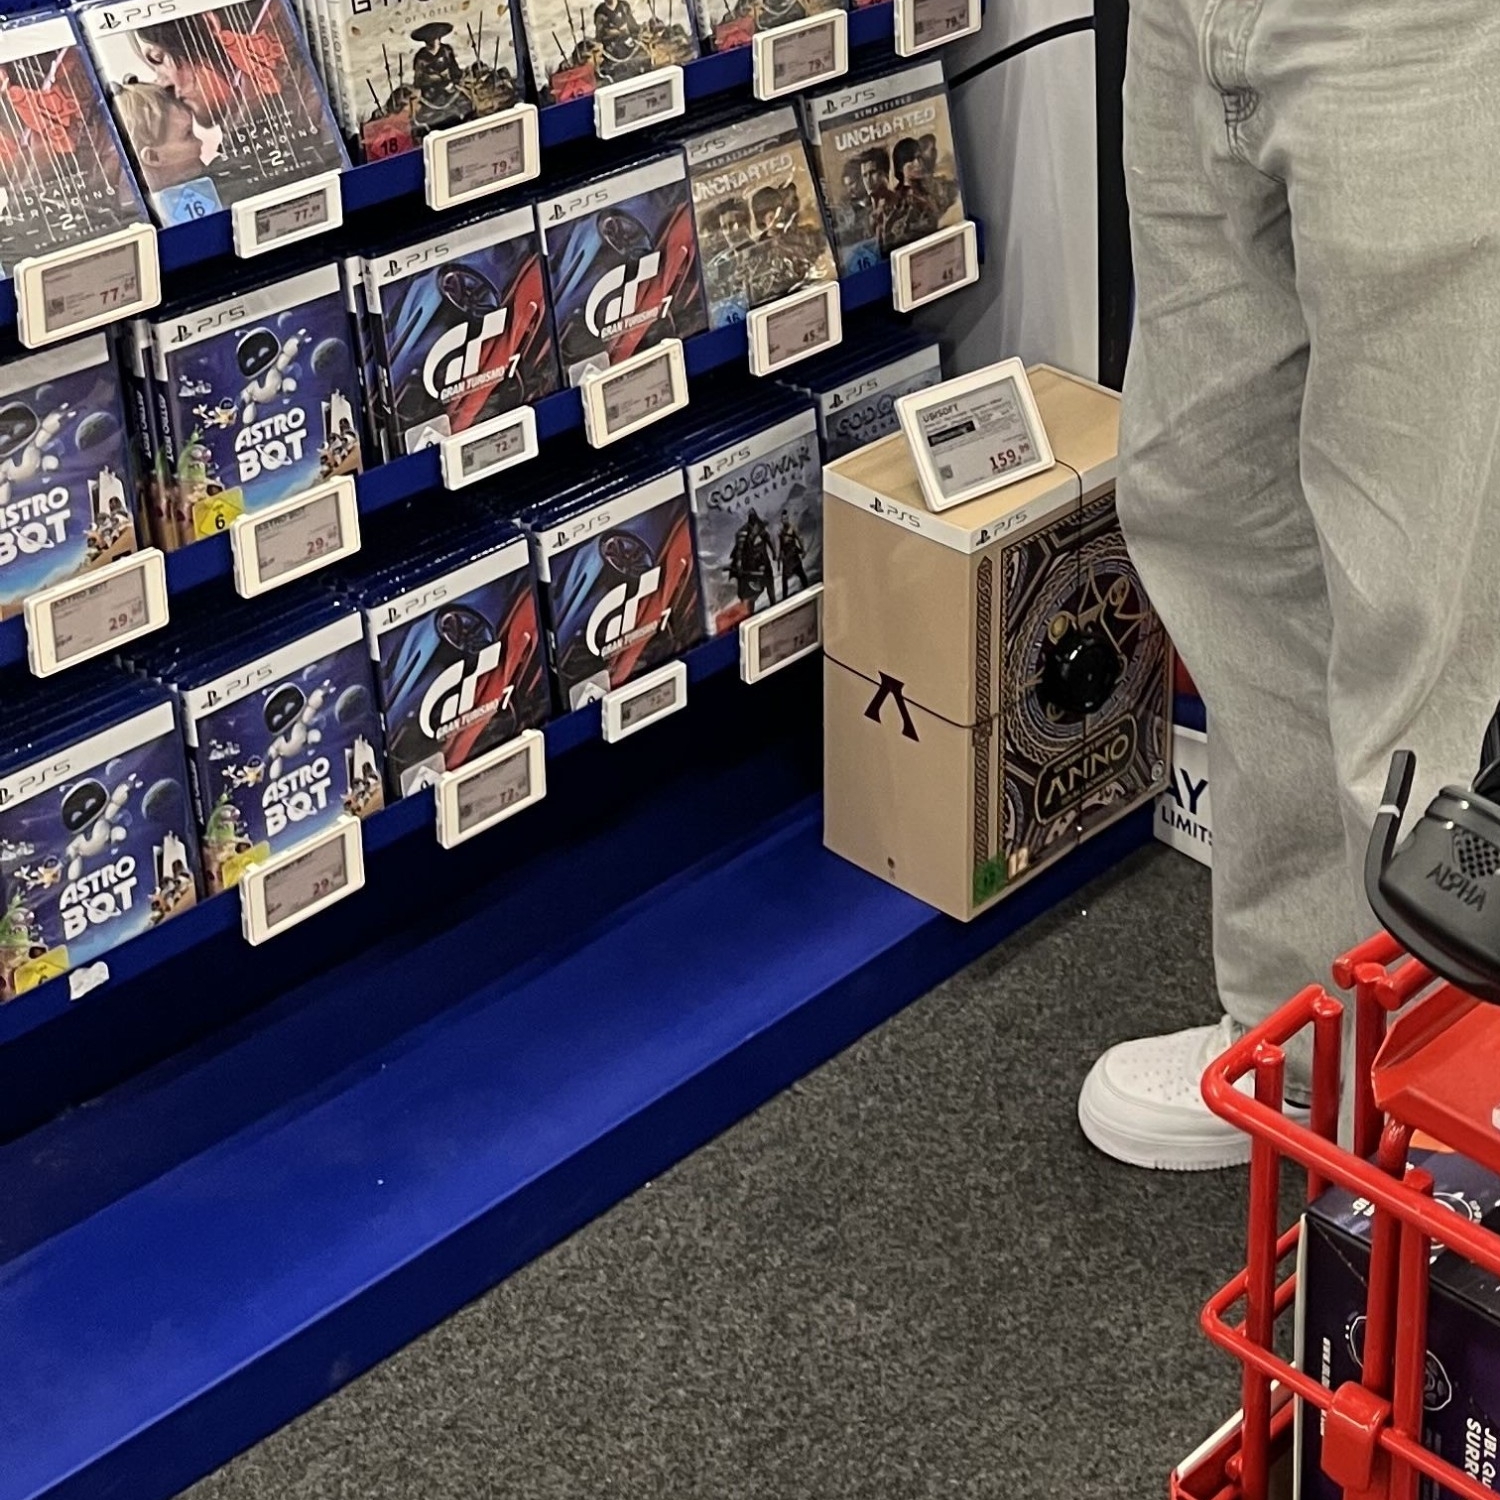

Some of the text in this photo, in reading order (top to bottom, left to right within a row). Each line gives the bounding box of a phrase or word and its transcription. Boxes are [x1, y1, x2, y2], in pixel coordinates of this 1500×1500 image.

[126, 0, 177, 22] PS5
[840, 88, 876, 108] PS5
[834, 105, 937, 152] UNCHARTED
[268, 150, 285, 167] 2
[380, 136, 399, 155] 18
[184, 201, 206, 218] 16
[569, 189, 609, 213] PS5
[58, 213, 77, 231] 2
[405, 245, 450, 269] PS5
[100, 276, 136, 305] 77.
[198, 305, 246, 332] PS5
[661, 295, 673, 319] 7
[507, 353, 521, 379] 7
[845, 377, 879, 395] PS5
[234, 407, 307, 454] ASTRO
[236, 430, 309, 484] BOT
[717, 446, 751, 471] PS5
[764, 444, 812, 479] WAR
[215, 511, 226, 531] 6
[573, 511, 612, 537] PS5
[887, 504, 921, 529] PS5
[993, 510, 1028, 538] PS5
[405, 584, 448, 615] PS5
[660, 607, 672, 632] 7
[226, 665, 274, 697] PS5
[501, 684, 515, 711] 7
[19, 759, 72, 793] PS5
[261, 756, 331, 810] ASTRO
[263, 778, 332, 838] BOT
[58, 855, 137, 910] ASTRO
[1425, 860, 1488, 913] ALPHA
[61, 877, 139, 942] BOT
[1482, 1427, 1498, 1457] JBL
